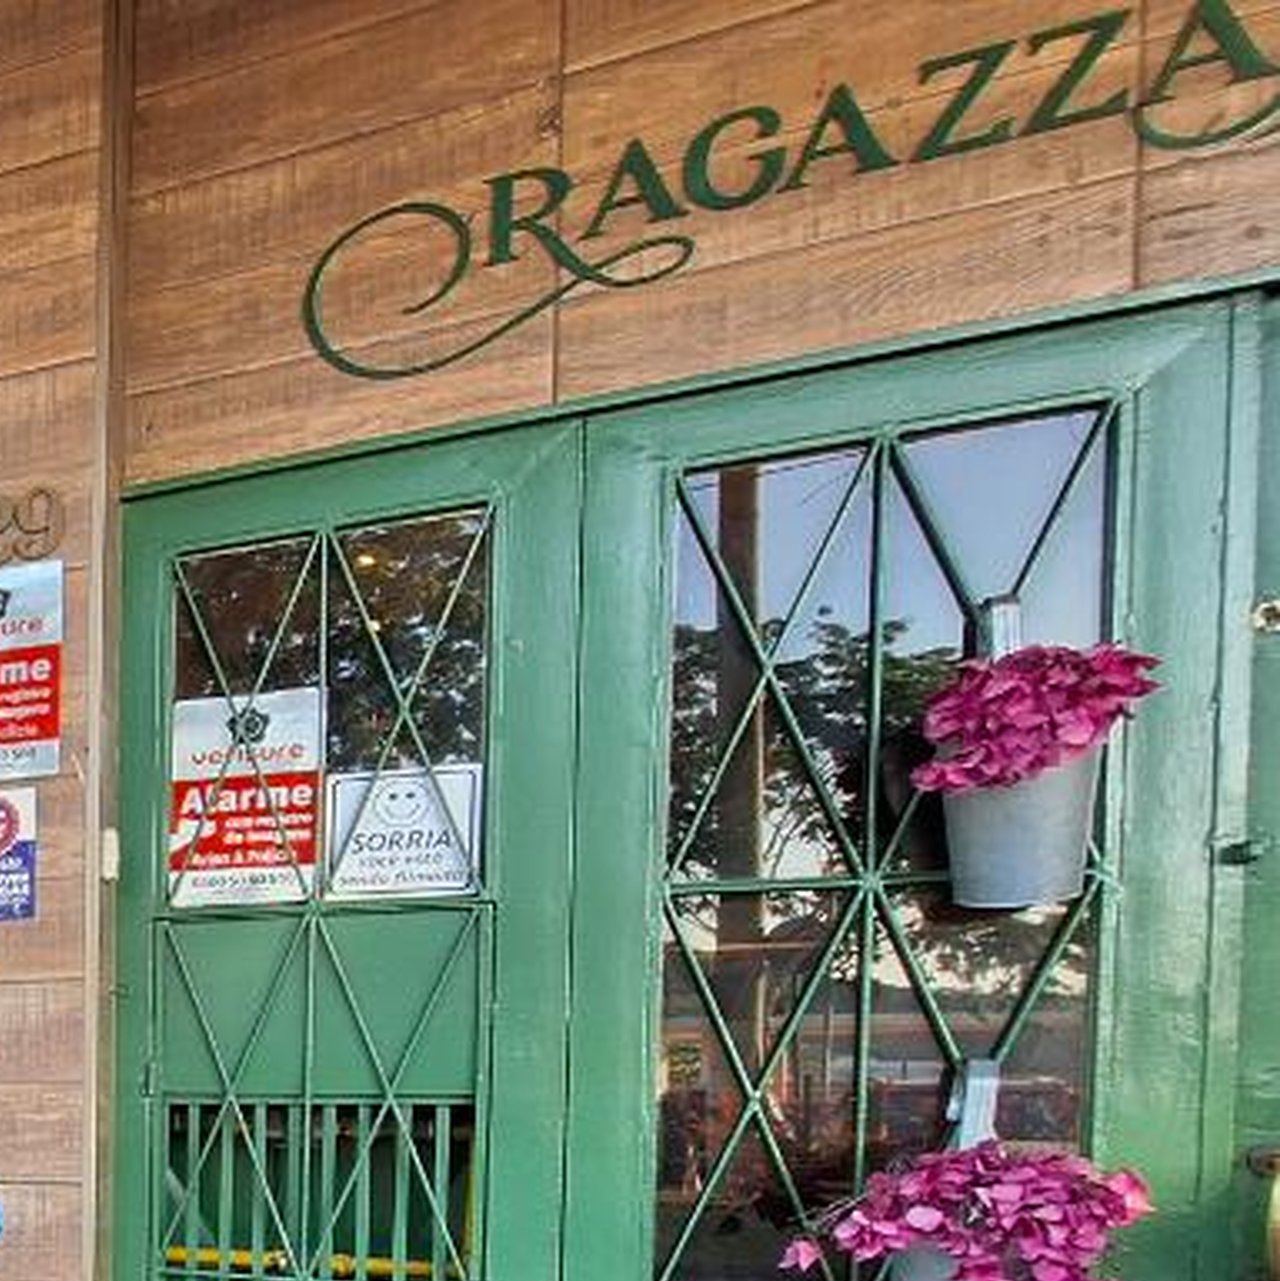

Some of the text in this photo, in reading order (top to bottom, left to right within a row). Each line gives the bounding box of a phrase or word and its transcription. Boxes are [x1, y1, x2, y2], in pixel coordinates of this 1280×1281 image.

[191, 743, 306, 766] verisure
[181, 782, 313, 816] Alarme
[351, 829, 452, 854] SORRIA
